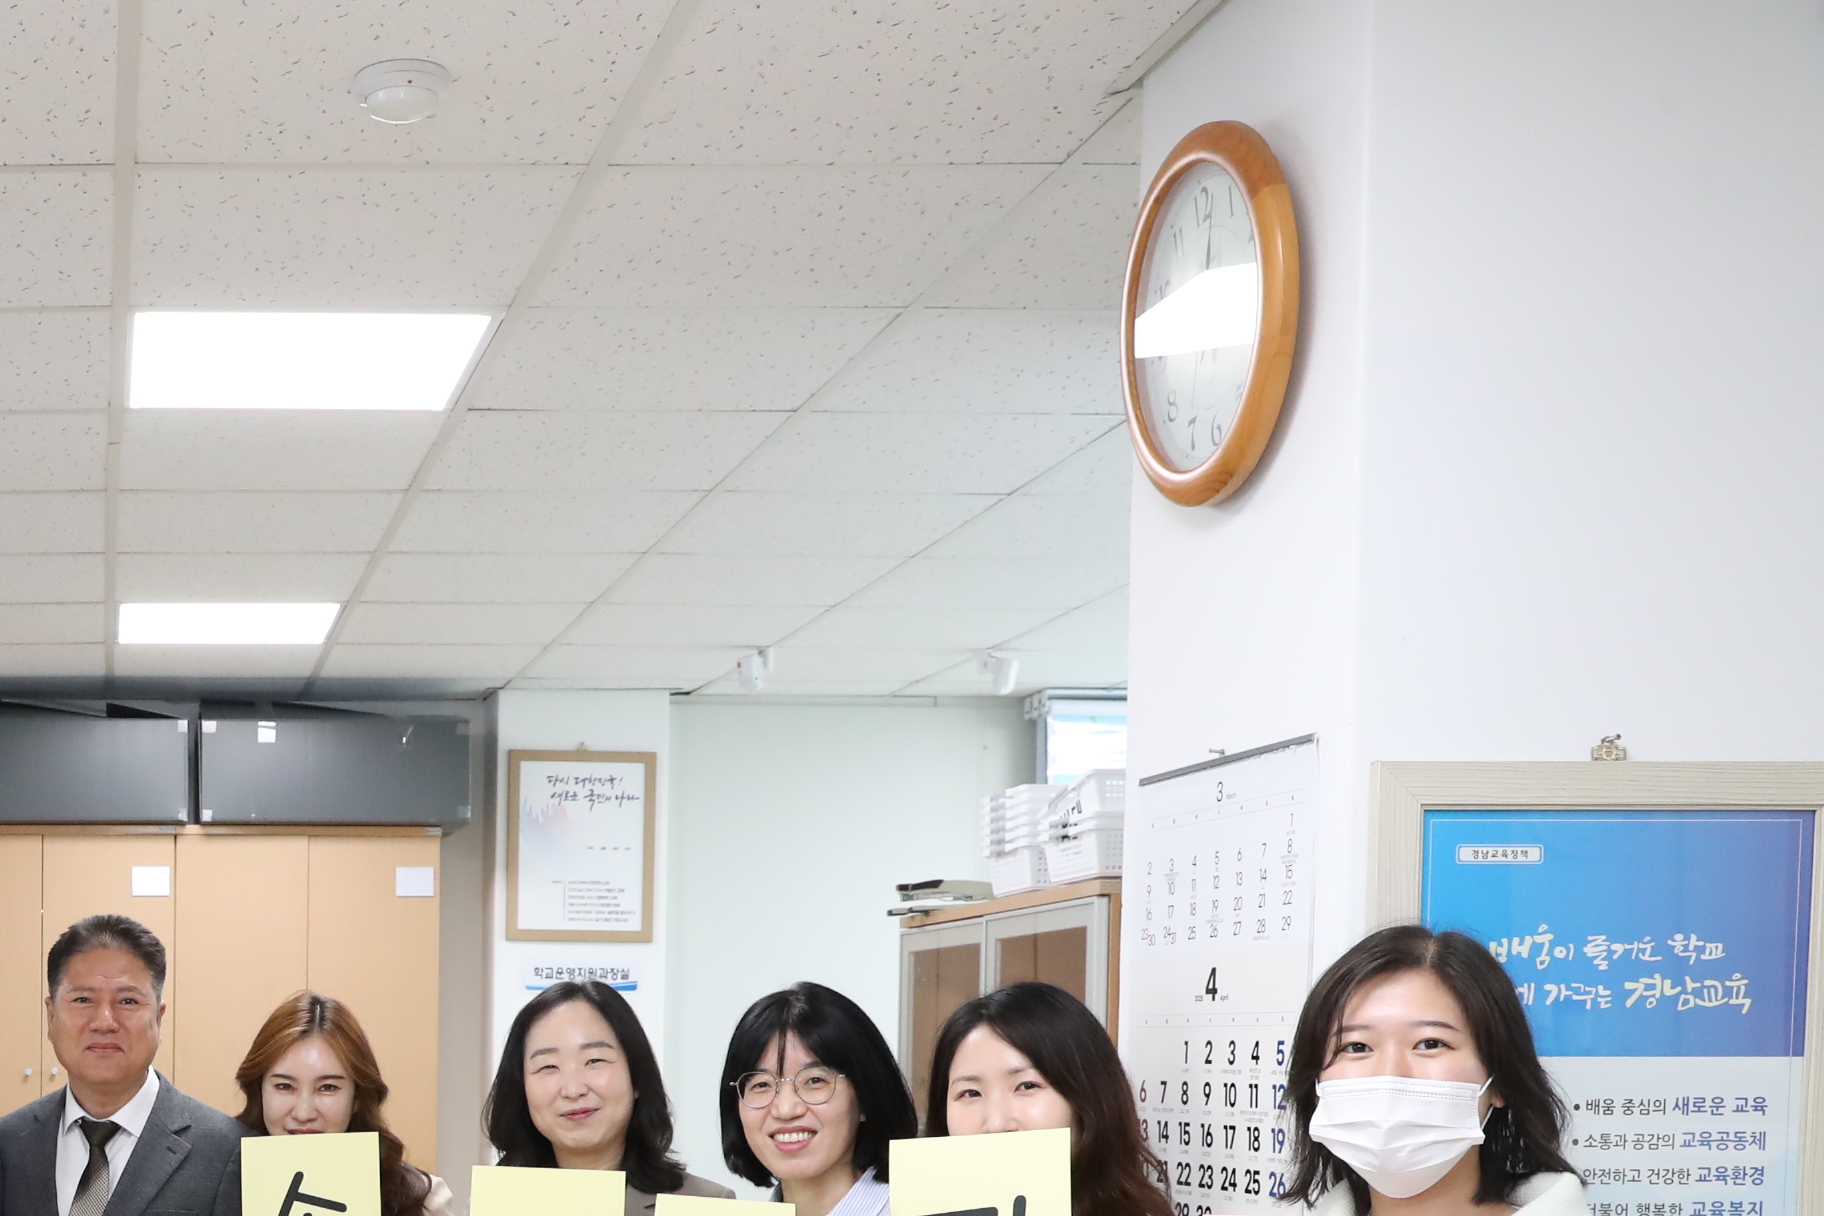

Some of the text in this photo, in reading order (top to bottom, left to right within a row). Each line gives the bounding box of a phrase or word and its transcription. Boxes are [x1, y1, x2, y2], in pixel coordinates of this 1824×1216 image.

[1193, 186, 1212, 228] 12
[1167, 389, 1178, 423] 8
[1187, 415, 1197, 451] 7
[1211, 409, 1222, 447] 6
[546, 774, 570, 787] 다시
[1216, 781, 1224, 802] 3
[550, 788, 641, 812] 새로운 국민의 나라
[1237, 847, 1242, 861] 6
[1262, 843, 1267, 858] 7
[1287, 838, 1292, 853] 8
[1471, 849, 1529, 860] 경남교육정책
[1168, 881, 1175, 895] 10
[1213, 875, 1219, 889] 12
[1236, 871, 1242, 886] 13
[1259, 868, 1267, 883] 14
[1285, 864, 1293, 879] 15
[1146, 889, 1292, 921] 16 17 18 19 20 21 22
[1188, 926, 1196, 940] 25
[1209, 923, 1218, 938] 26
[1233, 921, 1242, 936] 27
[1256, 918, 1266, 934] 28
[1281, 915, 1292, 931] 29
[1489, 923, 1726, 971] 배움이 즐거운 학교
[533, 967, 630, 981] 학교운영지원과장실
[1205, 966, 1218, 1001] 4
[1543, 982, 1612, 1010] 가꾸는
[1624, 972, 1752, 1015] 경남교육
[1183, 1040, 1285, 1066] 1 2 3 4 5
[1139, 1080, 1287, 1109] 6 7 8 9 10 11 12
[1585, 1095, 1768, 1116] 배움 중심의 새로운 교육
[1157, 1120, 1169, 1144] 14
[1178, 1121, 1191, 1146] 15
[1200, 1123, 1213, 1148] 16
[1223, 1125, 1236, 1150] 17
[1246, 1126, 1261, 1152] 18
[1271, 1128, 1285, 1154] 19
[1583, 1130, 1766, 1151] 소통과 공감의 교육공동체
[1176, 1161, 1192, 1187] 22
[1198, 1163, 1214, 1190] 23
[1220, 1166, 1237, 1192] 24
[1244, 1169, 1261, 1195] 25
[1268, 1171, 1286, 1198] 26
[1582, 1165, 1765, 1186] 안전하고 건강한 교육환경
